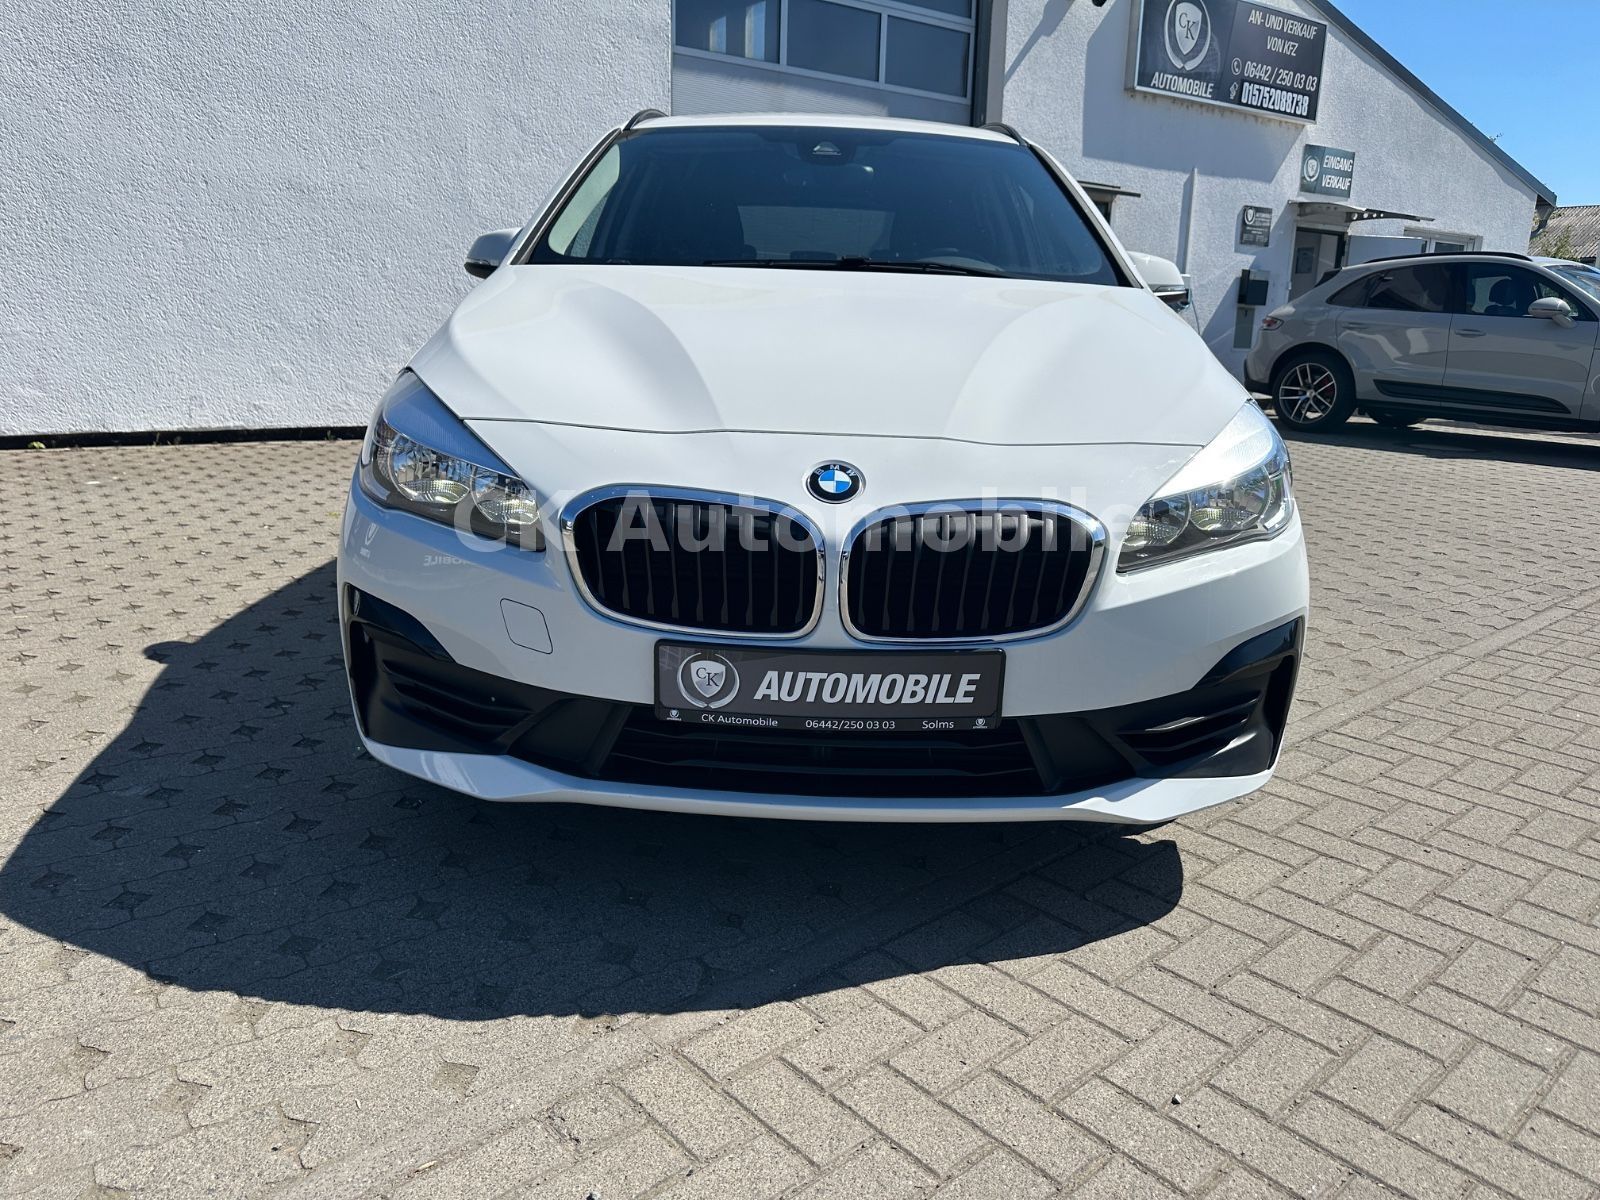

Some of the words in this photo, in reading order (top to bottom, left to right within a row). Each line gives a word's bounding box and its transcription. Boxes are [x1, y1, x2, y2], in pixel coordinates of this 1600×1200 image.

[1178, 12, 1196, 41] CK
[1248, 9, 1264, 25] AN-
[1265, 14, 1282, 31] UND
[1283, 16, 1318, 40] VERKAUF
[1266, 36, 1284, 53] VON
[1283, 41, 1299, 57] KFZ
[1150, 71, 1214, 98] AUTOMOBILE
[1243, 61, 1271, 81] 06442
[1276, 68, 1293, 86] 250
[1293, 72, 1306, 89] 03
[1305, 74, 1318, 91] 03
[1241, 82, 1310, 116] 015752088738
[1323, 155, 1353, 172] EINGANG
[1321, 174, 1352, 190] VERKAUF
[814, 464, 857, 477] BMW
[695, 666, 720, 688] CK
[753, 670, 981, 705] AUTOMOBILE
[701, 713, 716, 724] CK
[717, 714, 779, 728] Automobile
[805, 719, 865, 730] 06442/250
[866, 719, 881, 730] 03
[881, 719, 896, 730] 03
[921, 719, 955, 730] Solms
